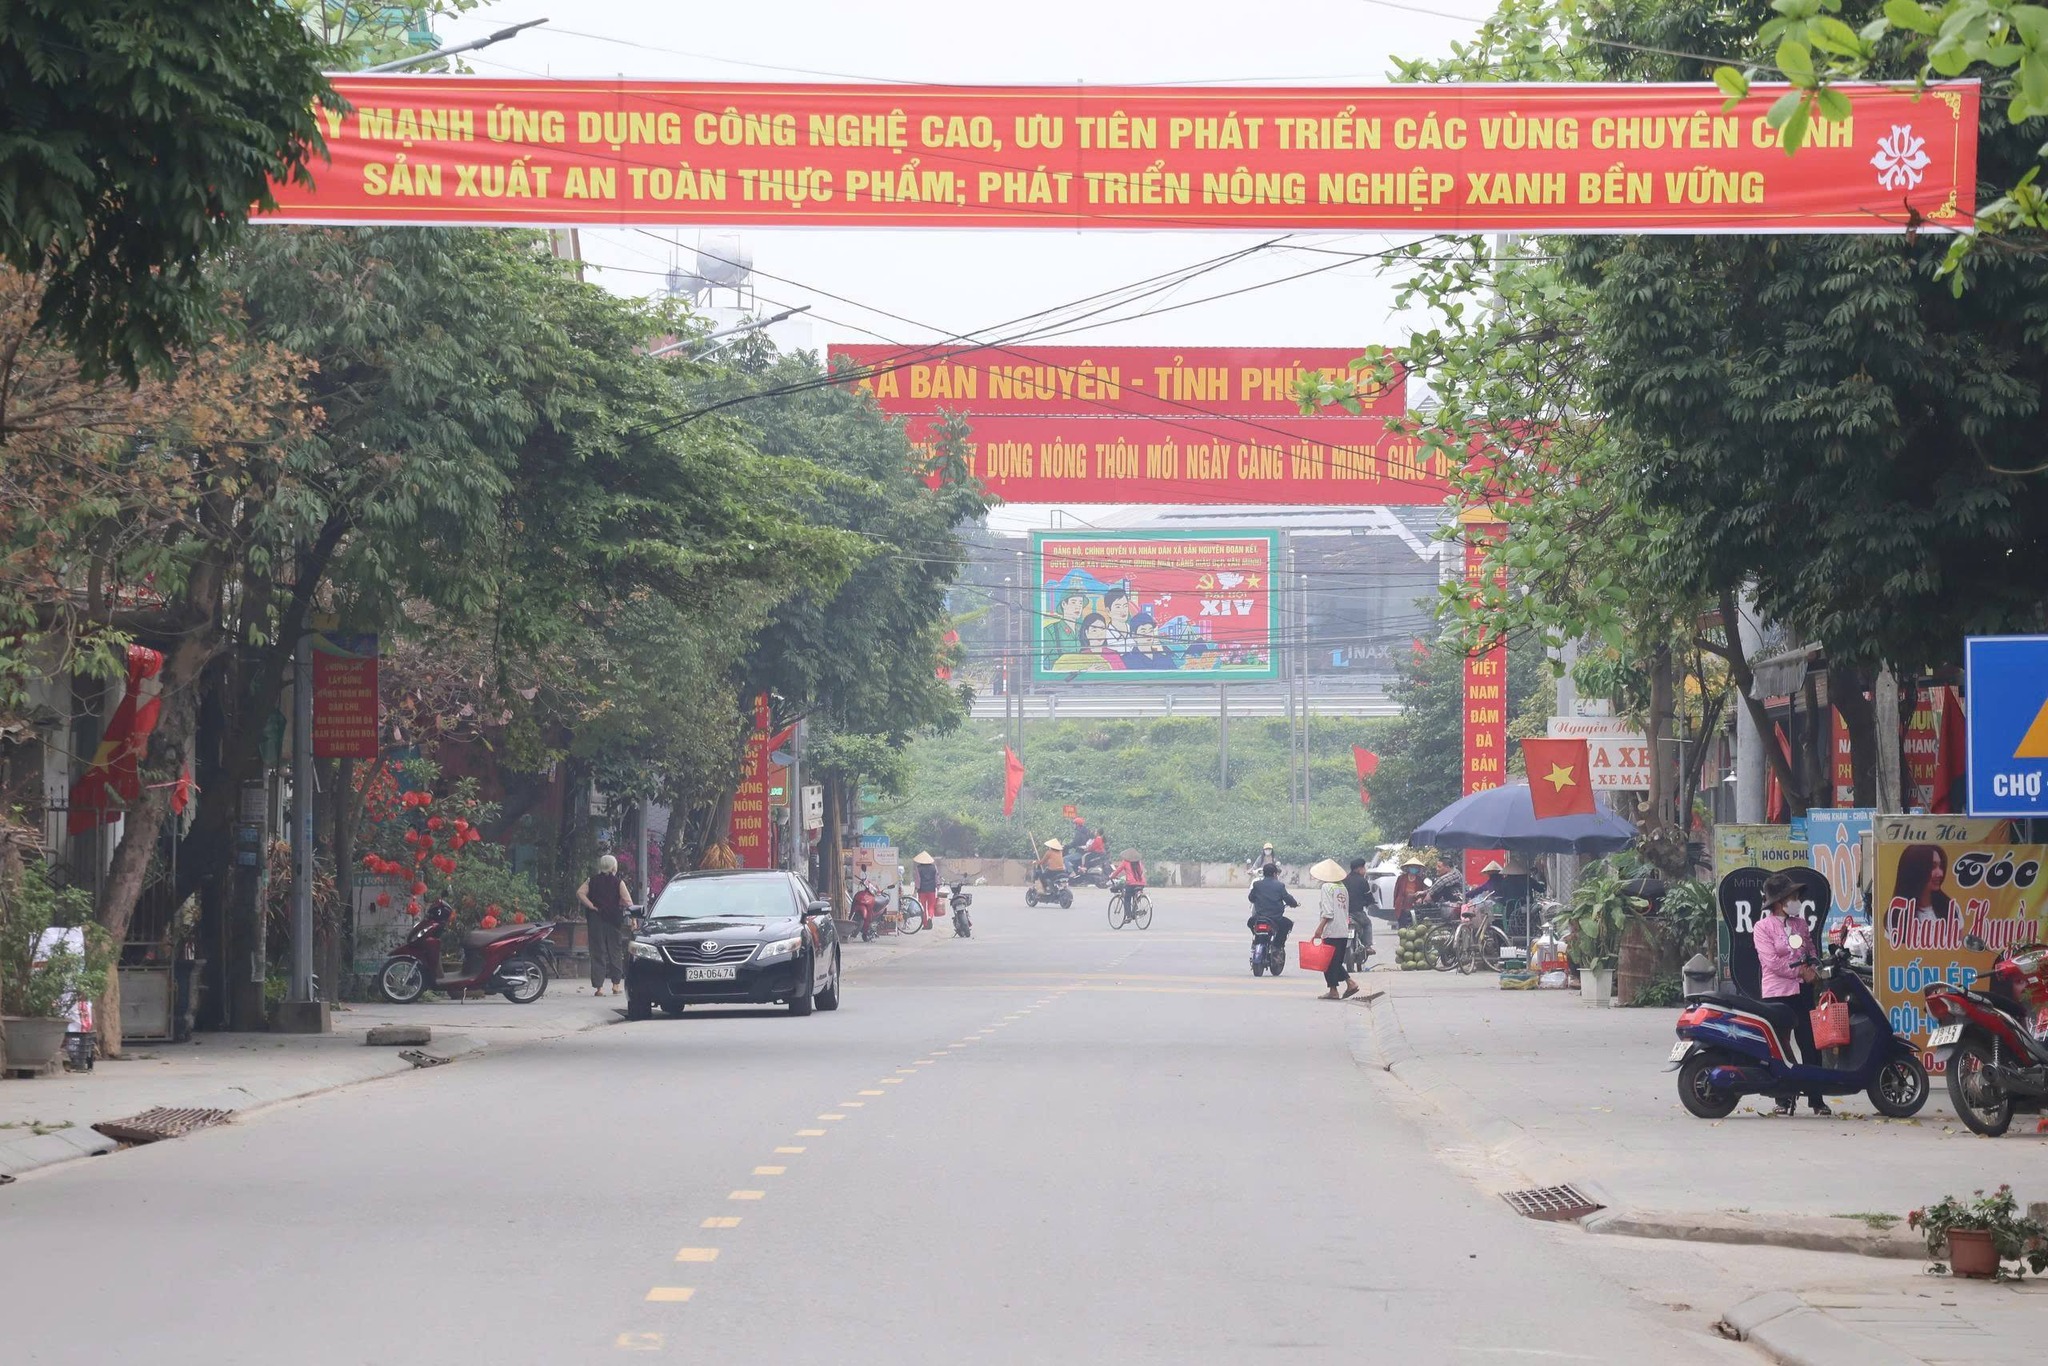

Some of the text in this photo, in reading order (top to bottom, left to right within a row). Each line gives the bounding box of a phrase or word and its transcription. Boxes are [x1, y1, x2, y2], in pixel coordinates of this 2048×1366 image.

[359, 107, 474, 147] MẠNH
[487, 103, 564, 144] ỨNG
[579, 112, 681, 151] DỤNG
[694, 107, 796, 146] CÔNG
[809, 108, 908, 154] NGHỆ
[921, 116, 1003, 152] CAO,
[1015, 113, 1063, 148] ƯU
[1075, 110, 1157, 149] TIÊN
[1169, 111, 1263, 150] PHÁT
[1275, 104, 1381, 150] TRIỂN
[1394, 112, 1467, 150] CÁC
[1480, 111, 1578, 150] VÙNG
[1591, 110, 1739, 149] CHUYÊN
[1751, 115, 1854, 150] CNH
[363, 153, 1765, 211] SẢN XUẤT AN TOÀN THỰC PHẨM; PHÁT TRIỂN NÔNG NGHIỆP XANH BỀN VỮNG
[988, 360, 1121, 400] NGUYÊN
[1154, 355, 1229, 401] TỈNH
[987, 439, 1032, 485] DỰNG
[1040, 436, 1087, 479] NÔNG
[1096, 437, 1139, 479] THÔN
[1146, 435, 1179, 480] MỚI
[1186, 437, 1231, 480] NGÀY
[1237, 438, 1284, 480] CÀNG
[1290, 439, 1324, 480] VĂN
[1331, 445, 1381, 486] MINH,
[1387, 437, 1427, 481] GIÀU
[1200, 600, 1254, 615] XIV
[1472, 659, 1497, 679] VIỆT
[1470, 685, 1499, 700] NAM
[1470, 705, 1499, 725] ĐẬM
[1555, 721, 1608, 735] Nguyễn
[1476, 731, 1493, 748] ĐÀ
[1471, 754, 1498, 772] BẢN
[1598, 774, 1617, 785] XE
[1994, 772, 2041, 801] CHỢ
[734, 798, 763, 812] NÔNG
[735, 815, 762, 829] THÔN
[738, 832, 759, 847] MỚI
[1885, 824, 1968, 841] Thu Hà
[1954, 851, 2039, 888] Tóc
[1735, 900, 1818, 933] RG
[1889, 897, 2039, 958] Thanh Huyền
[1888, 958, 1977, 992] UỐN ÉP
